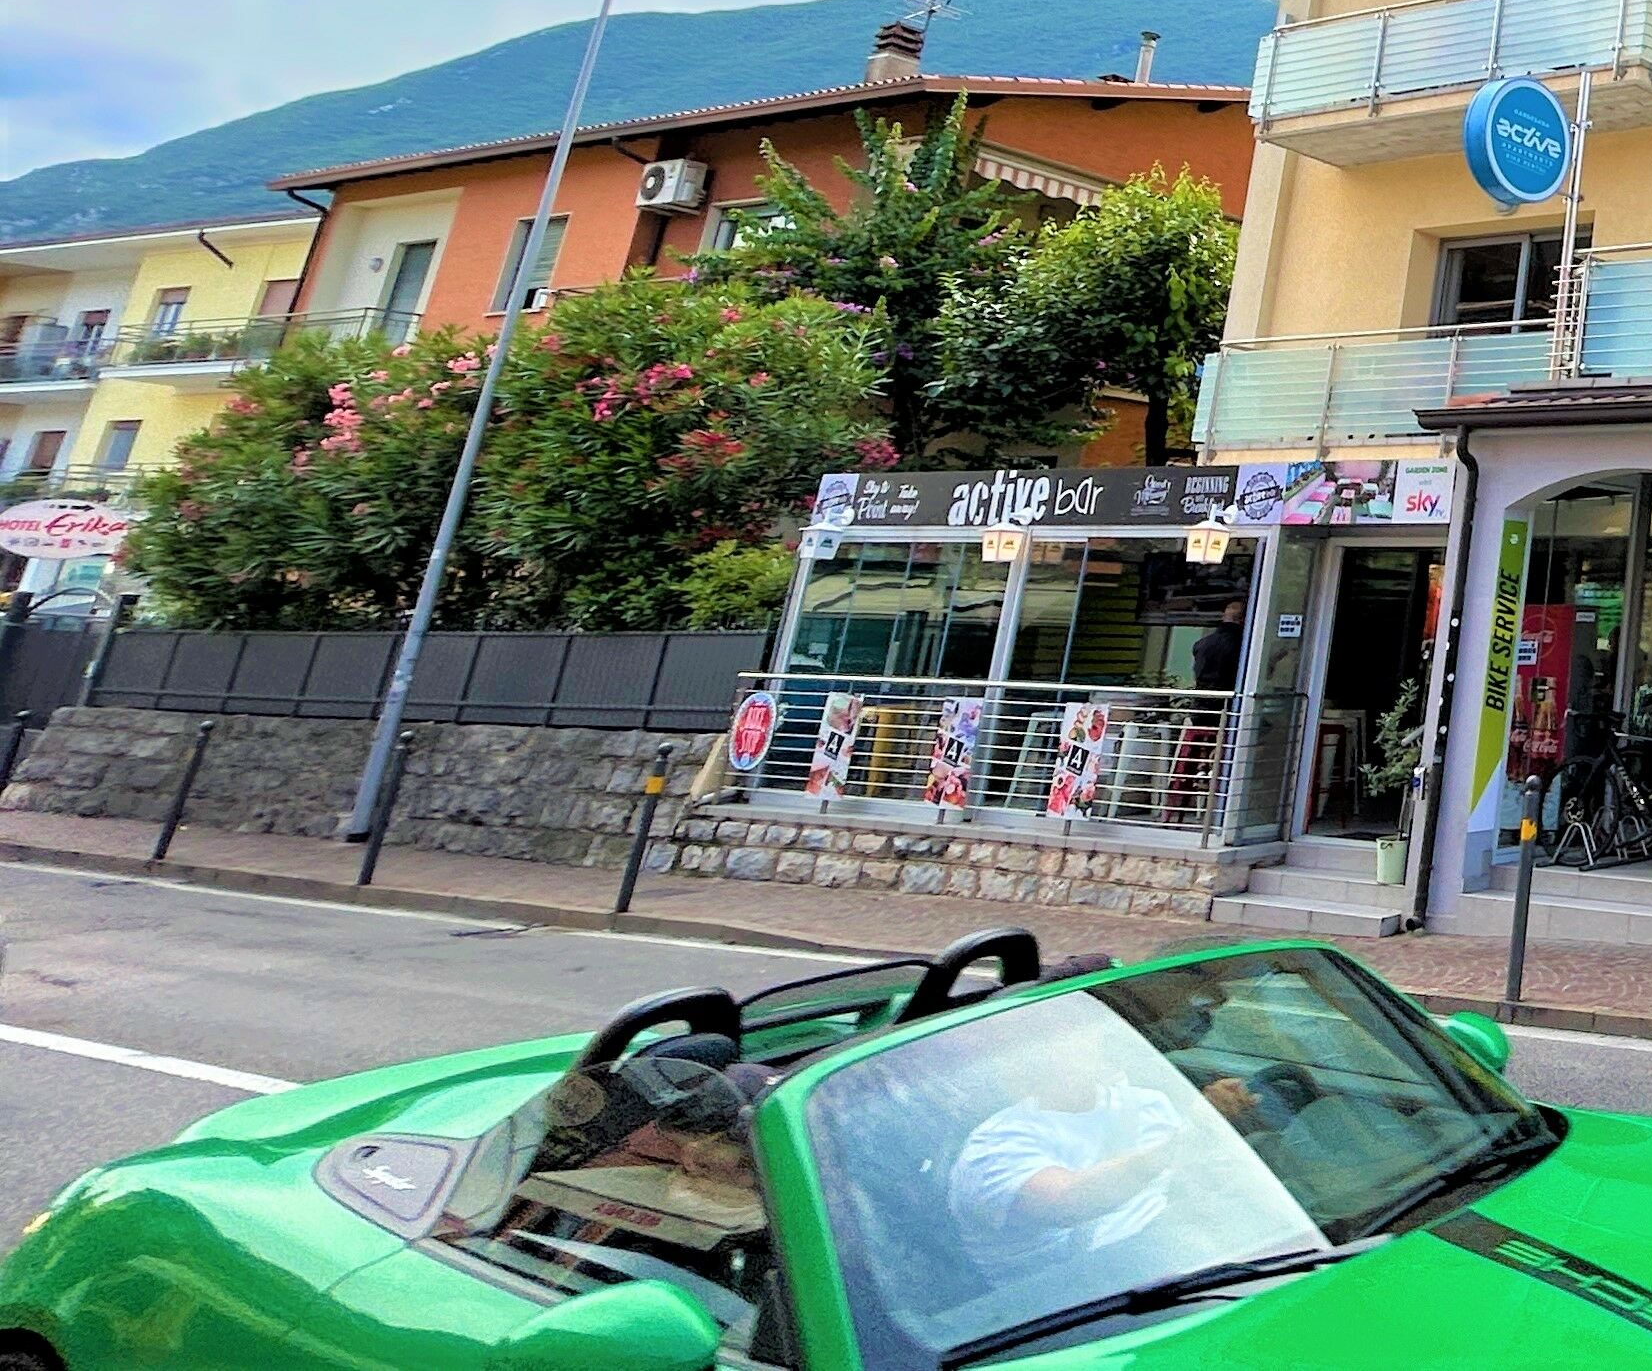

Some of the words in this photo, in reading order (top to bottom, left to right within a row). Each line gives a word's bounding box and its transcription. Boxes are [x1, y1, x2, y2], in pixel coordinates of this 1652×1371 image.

[1496, 116, 1562, 159] active
[948, 469, 1051, 526] active
[1053, 476, 1105, 516] bar
[1405, 489, 1441, 517] sky
[1490, 569, 1521, 659] SERVICE
[1486, 659, 1510, 713] BIKE
